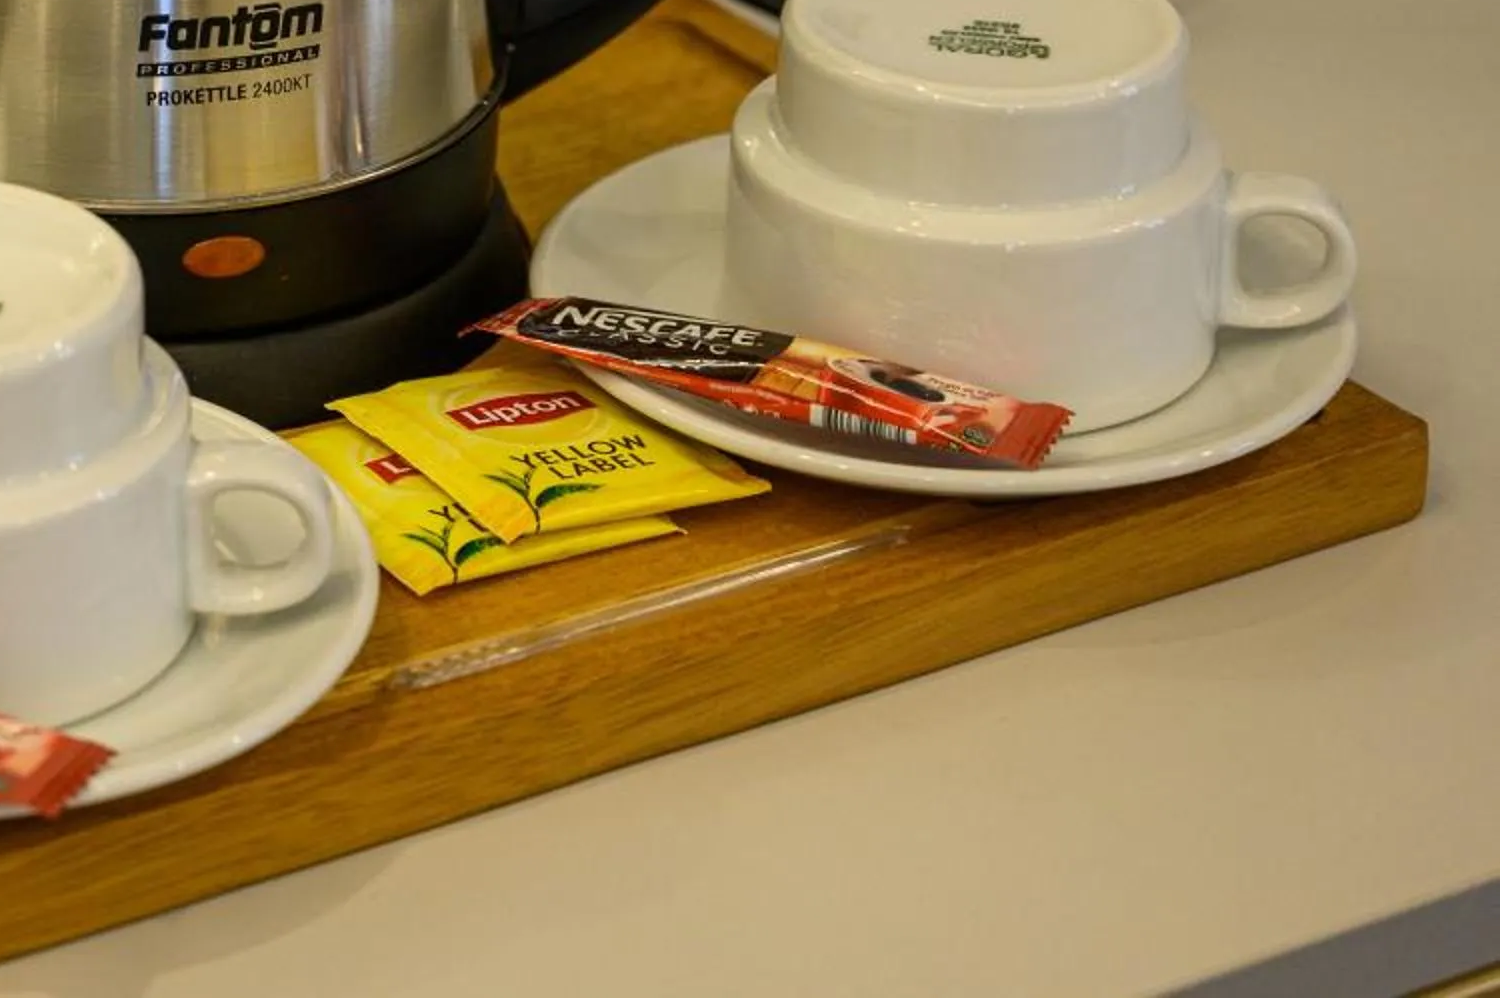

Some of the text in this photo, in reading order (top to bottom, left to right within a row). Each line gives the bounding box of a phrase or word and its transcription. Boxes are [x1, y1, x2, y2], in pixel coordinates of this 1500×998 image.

[138, 47, 320, 75] PROFESSIONAL
[146, 73, 312, 106] PROKETTLE 2400KT
[557, 328, 731, 355] CLASSIC
[459, 395, 581, 425] Lipton
[509, 434, 647, 470] YELLOW
[548, 453, 655, 480] LABEL
